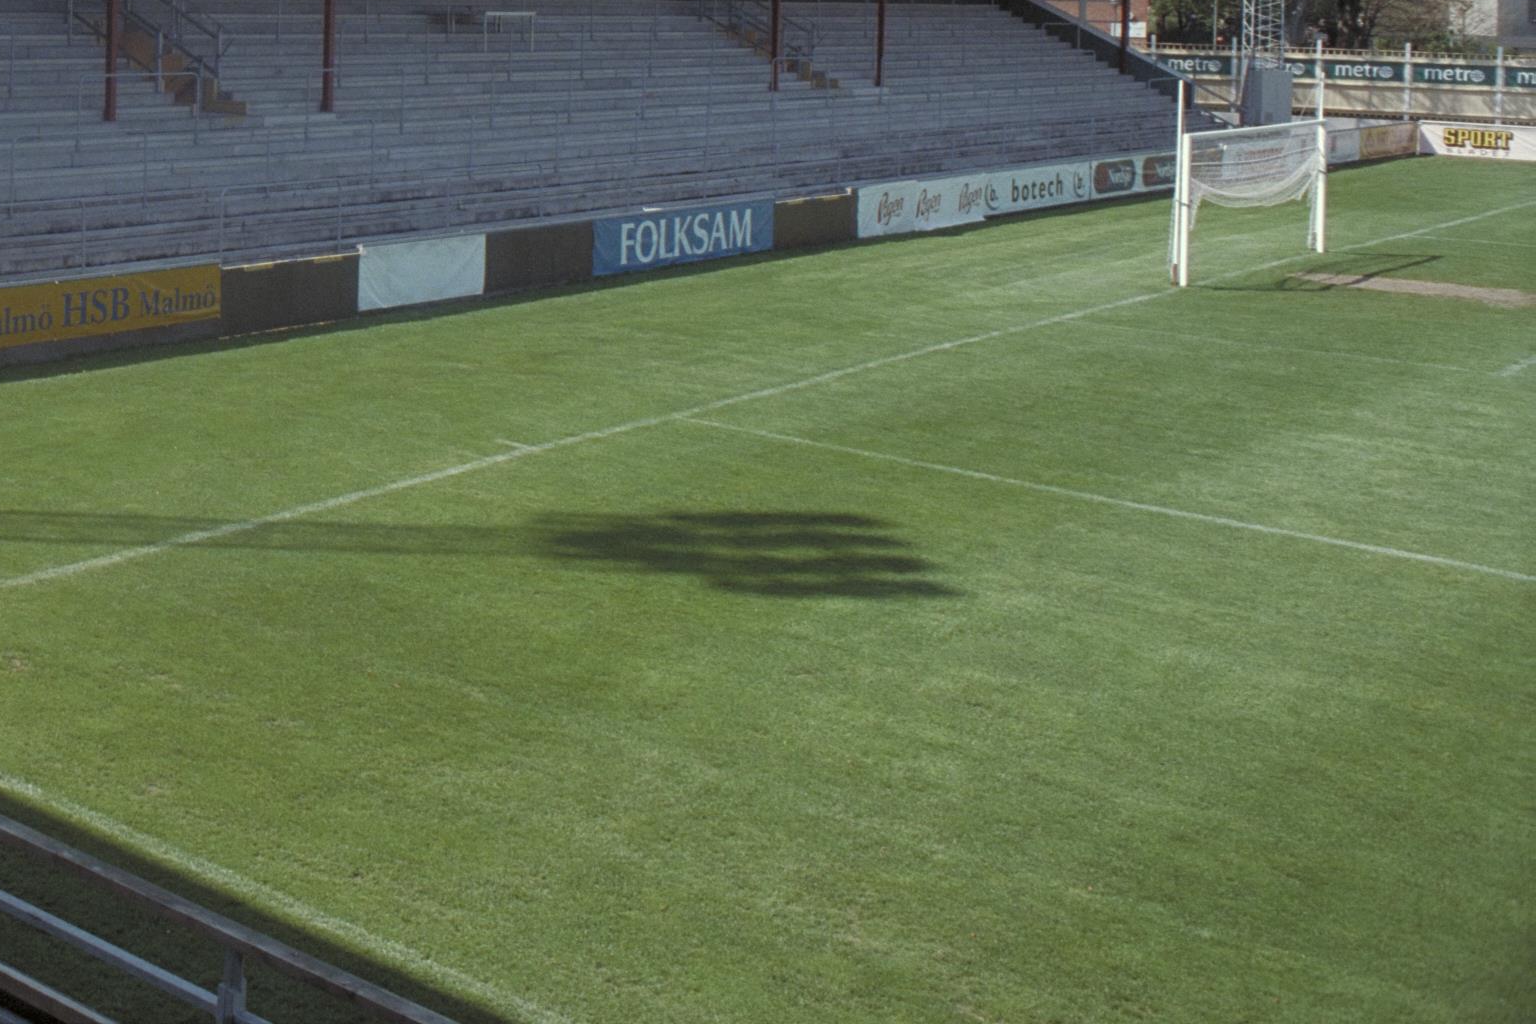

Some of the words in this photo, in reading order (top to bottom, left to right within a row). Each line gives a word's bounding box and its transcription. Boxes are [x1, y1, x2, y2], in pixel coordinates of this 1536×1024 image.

[1168, 59, 1222, 72] metro
[1335, 64, 1394, 79] metro
[1424, 67, 1485, 82] metro
[1444, 128, 1513, 150] SPORT
[1011, 172, 1063, 202] botech
[620, 208, 752, 265] FOLKSAM
[64, 287, 130, 328] HSB
[139, 284, 216, 319] Malmö
